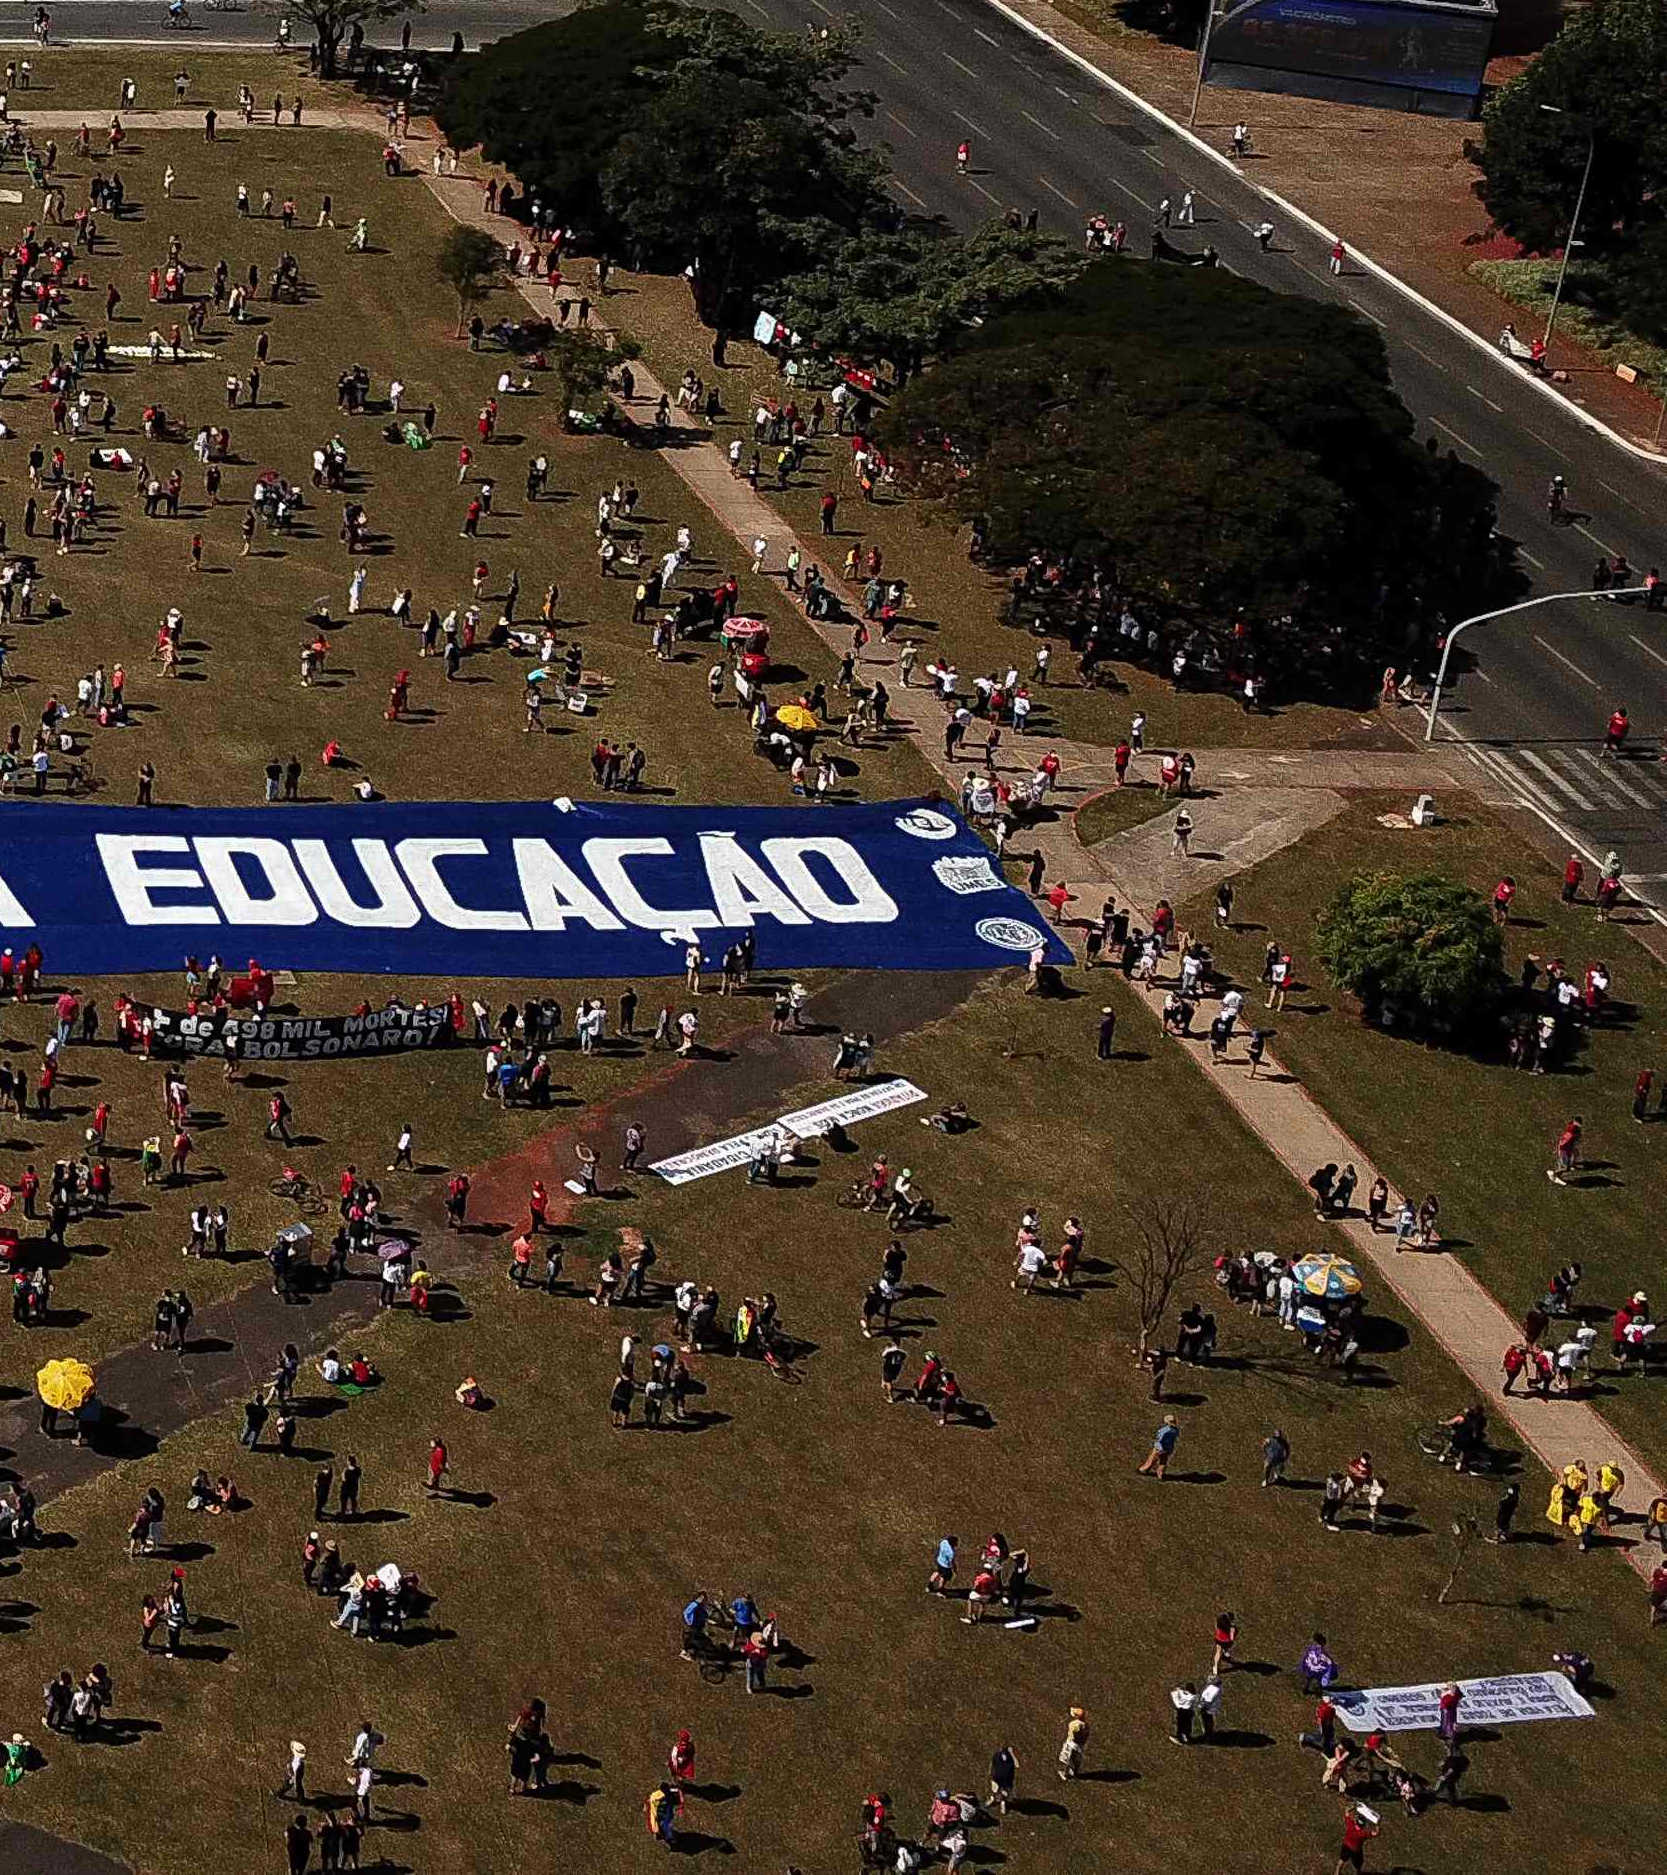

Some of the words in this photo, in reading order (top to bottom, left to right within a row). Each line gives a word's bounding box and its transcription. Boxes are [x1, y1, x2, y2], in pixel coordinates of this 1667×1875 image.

[95, 830, 899, 946] EDUCAÇÃO
[179, 1014, 214, 1036] de
[281, 1019, 331, 1039] MIL
[684, 1150, 750, 1177] CIDADANIA
